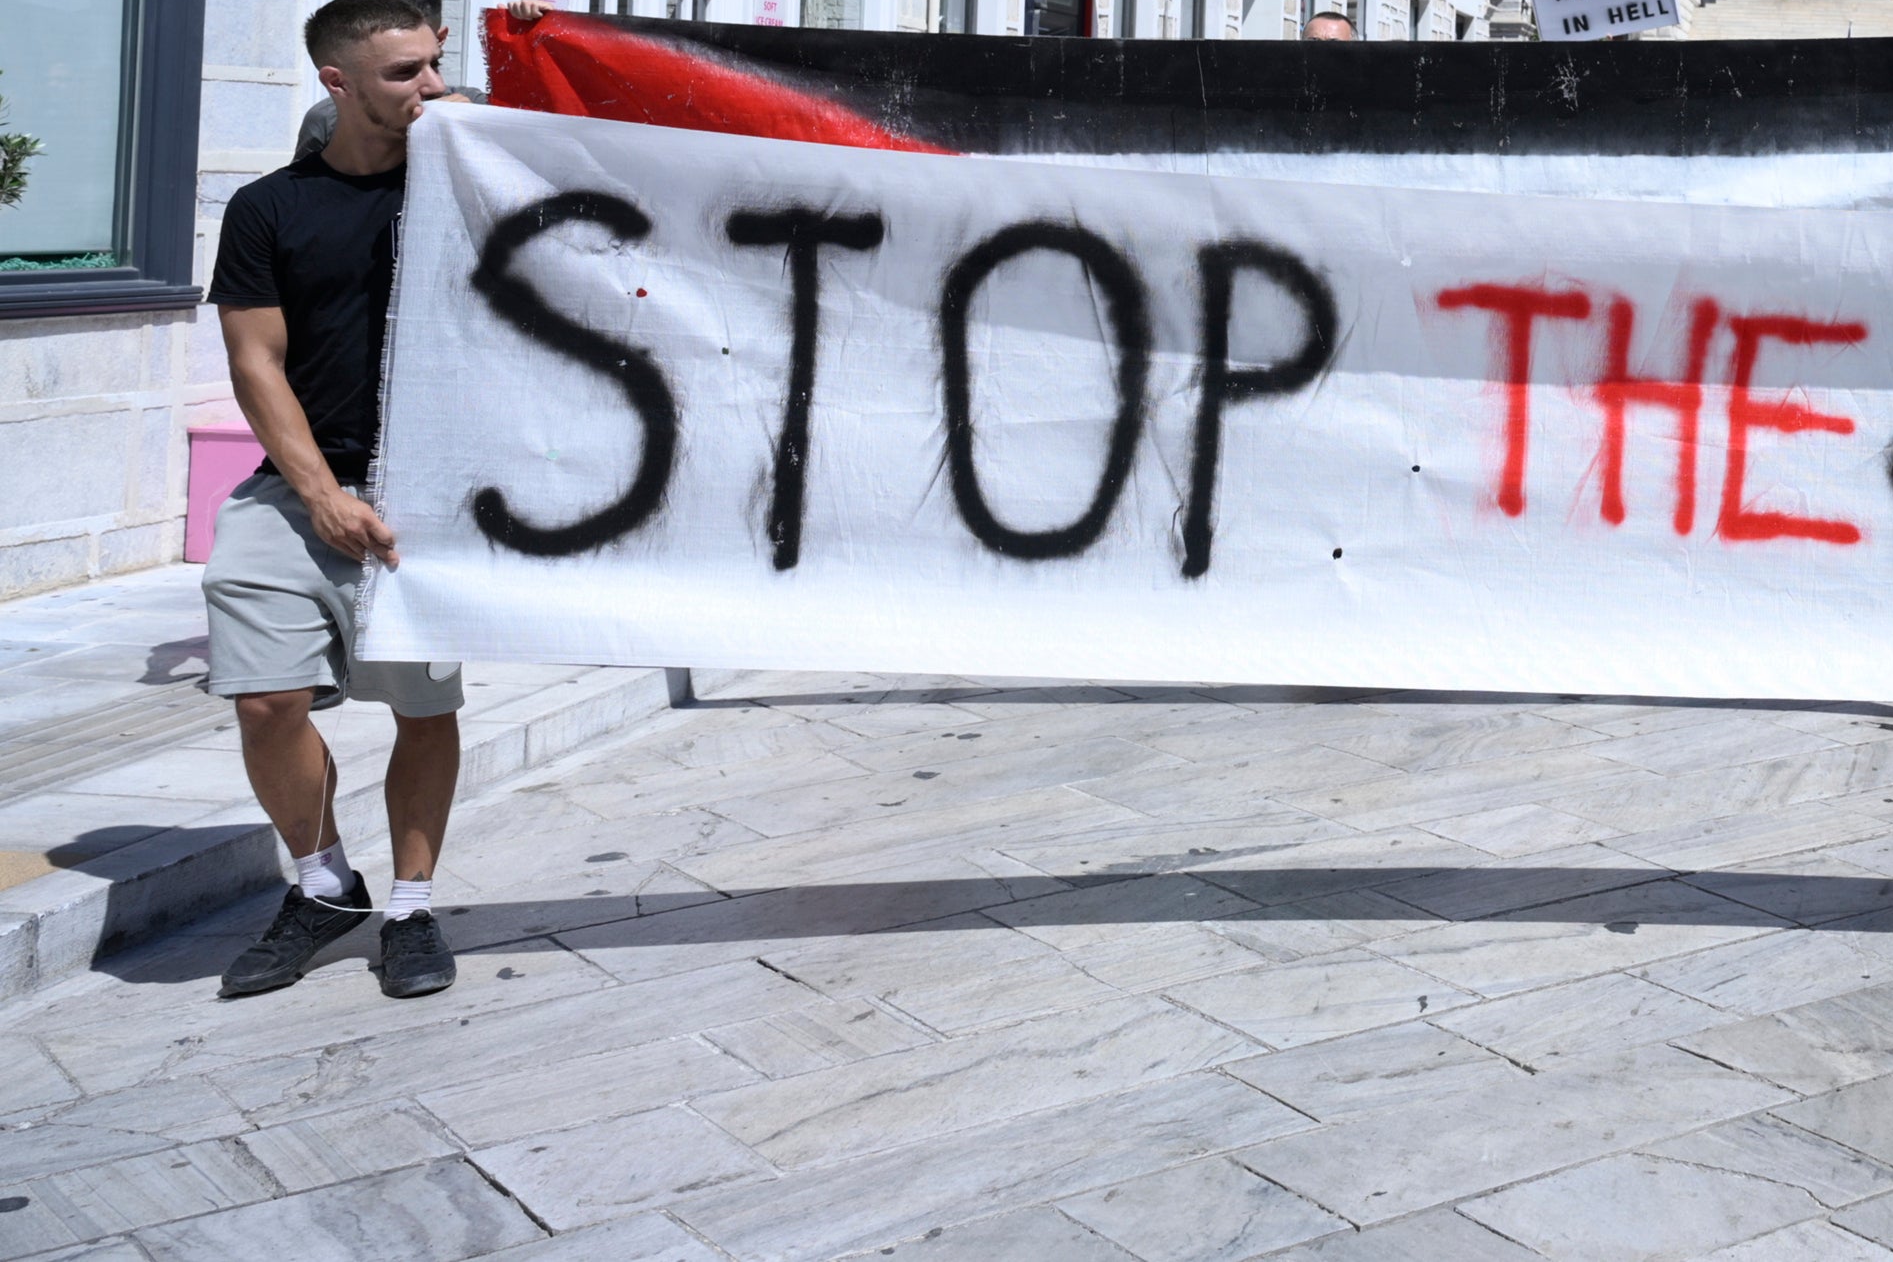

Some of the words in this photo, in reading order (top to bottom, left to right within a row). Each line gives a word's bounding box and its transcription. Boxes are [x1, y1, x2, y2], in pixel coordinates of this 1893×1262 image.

[1563, 14, 1590, 34] IN
[1608, 0, 1669, 24] HELL
[470, 190, 1338, 579] STOP
[1436, 283, 1868, 544] THE
